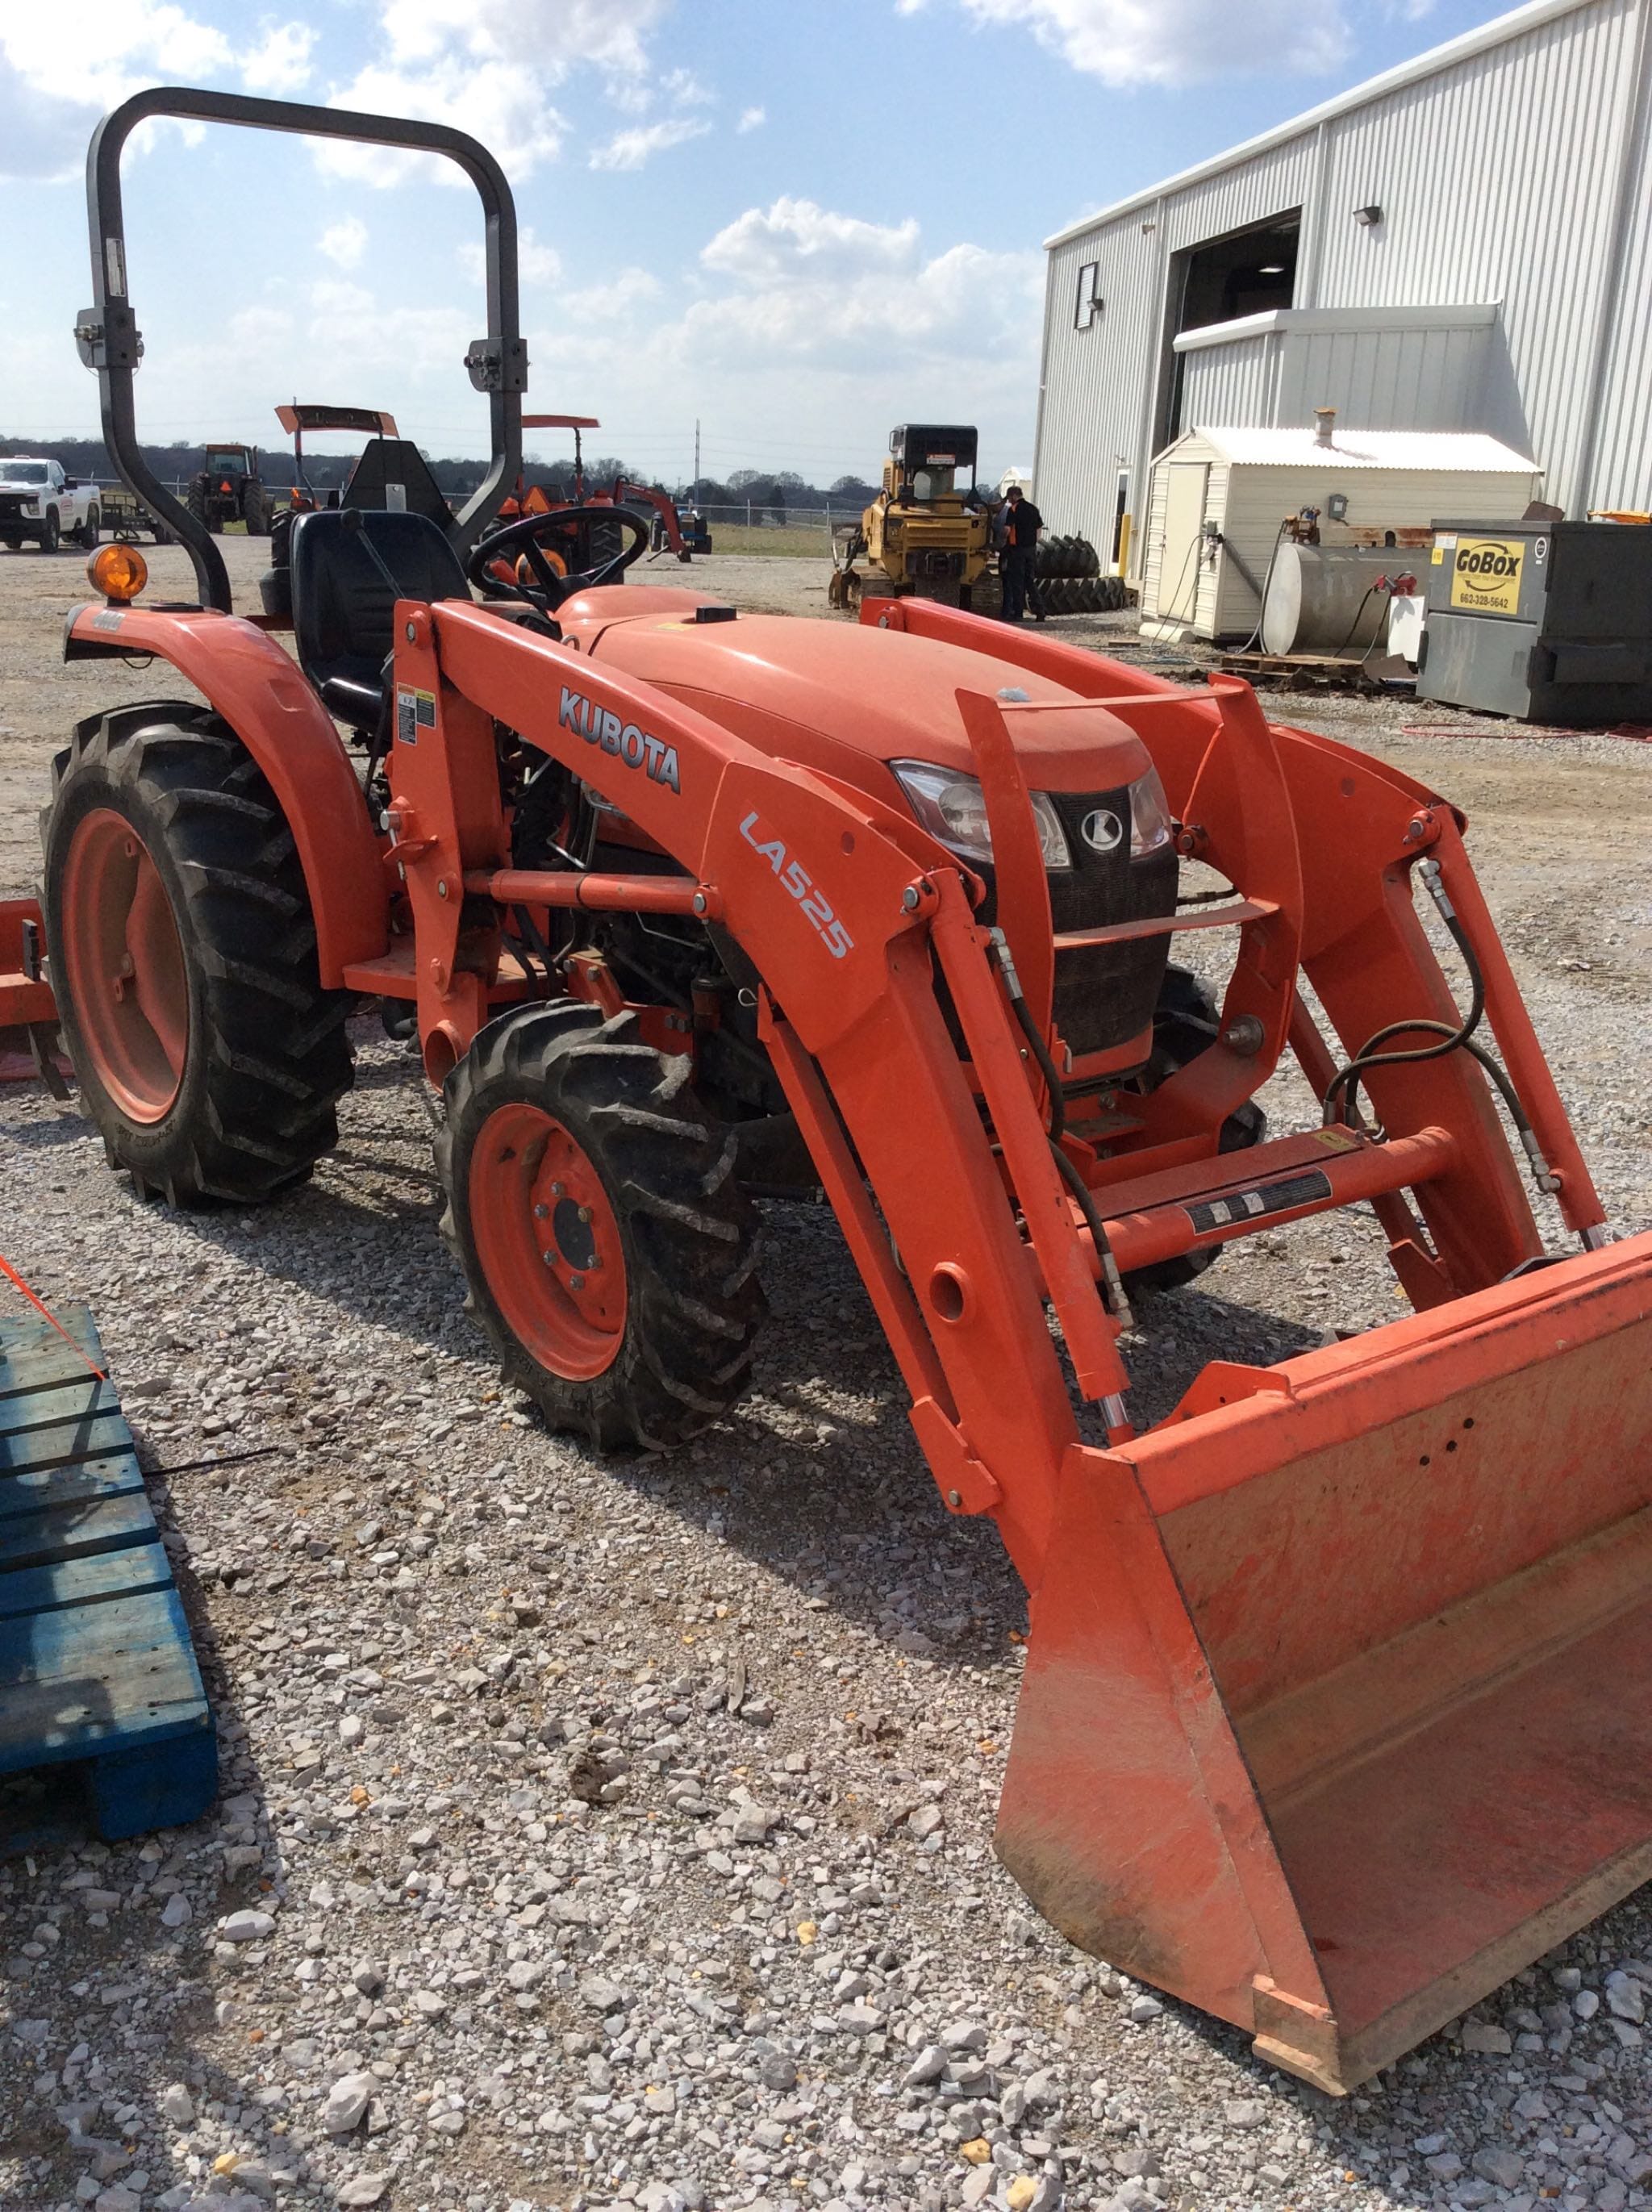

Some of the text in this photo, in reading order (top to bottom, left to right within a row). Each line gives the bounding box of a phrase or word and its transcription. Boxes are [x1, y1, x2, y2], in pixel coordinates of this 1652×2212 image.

[1457, 549, 1521, 576] GoBox
[1460, 593, 1508, 608] 662-328-5642
[558, 685, 681, 795] KUBOTA
[739, 812, 854, 959] LA525
